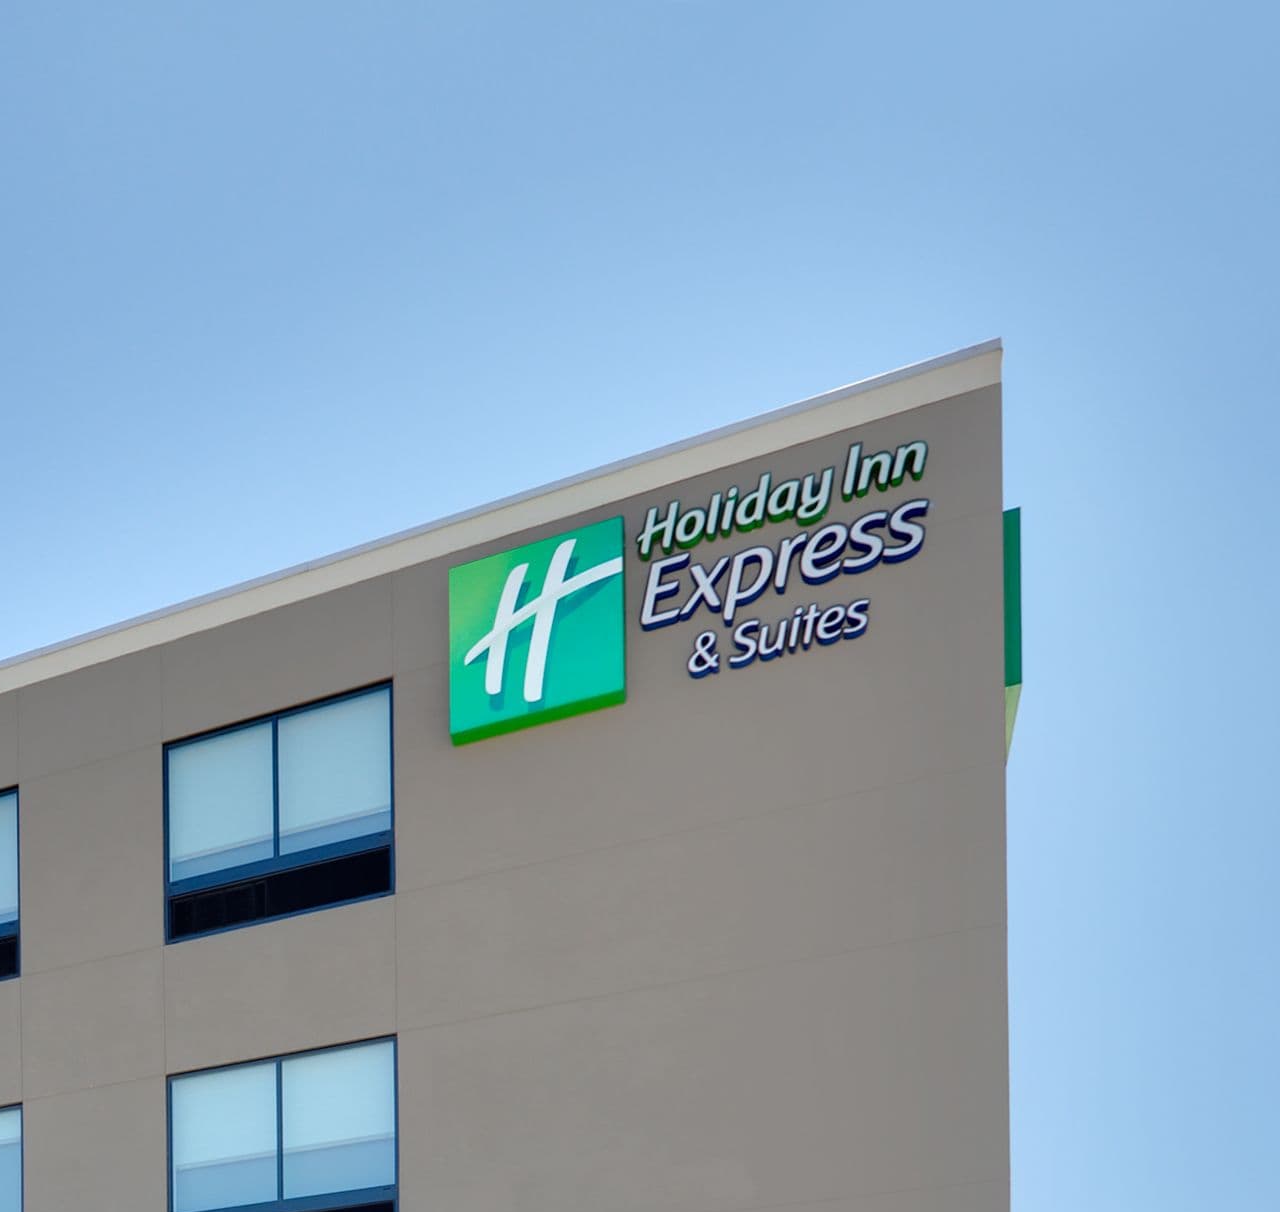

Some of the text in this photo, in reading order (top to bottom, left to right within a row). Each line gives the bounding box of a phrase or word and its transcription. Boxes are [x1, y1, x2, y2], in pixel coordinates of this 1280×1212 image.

[637, 440, 929, 561] Holiday Inn
[640, 498, 930, 631] Express
[687, 598, 871, 679] & Suites
